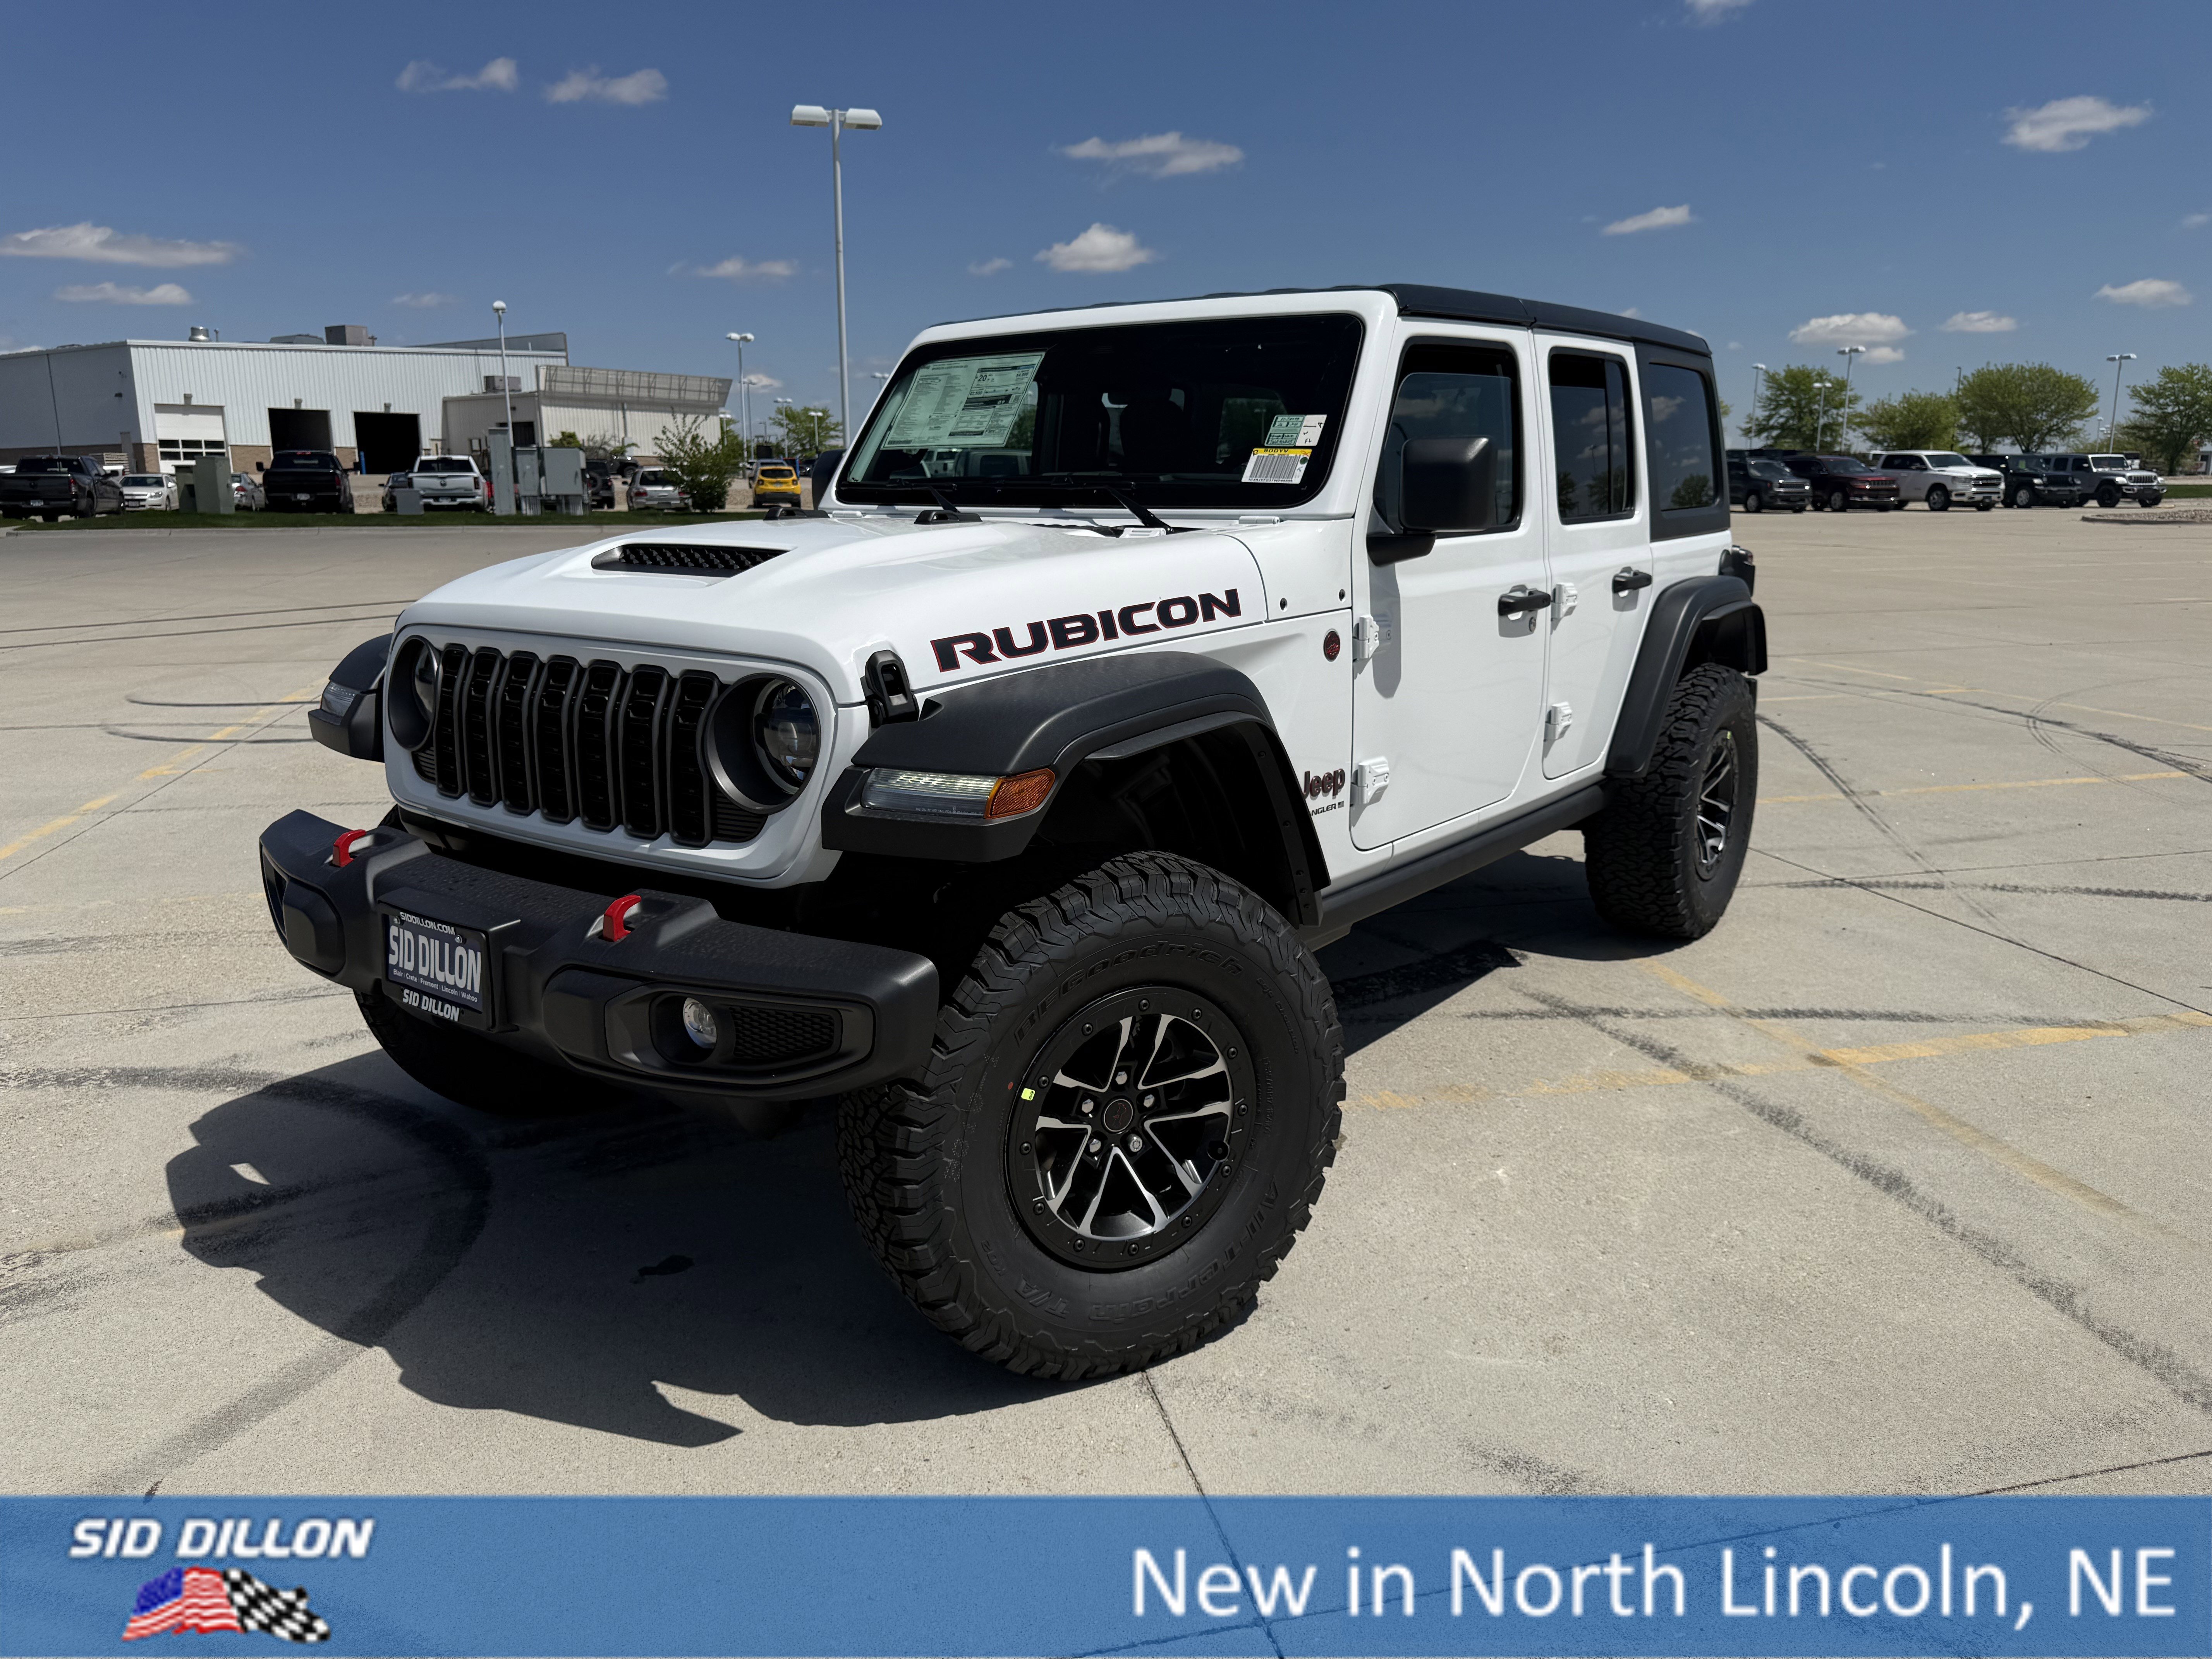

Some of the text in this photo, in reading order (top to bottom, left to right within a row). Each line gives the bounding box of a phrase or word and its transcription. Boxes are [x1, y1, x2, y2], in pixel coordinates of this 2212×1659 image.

[930, 588, 1242, 673] RUBICON
[1303, 768, 1345, 797] Jeep
[1311, 803, 1336, 816] NGLER
[400, 912, 455, 935] SIDDILLON.COM
[389, 925, 481, 993] SID DILLON
[406, 973, 417, 982] Crete
[420, 978, 438, 989] Fremont
[441, 985, 458, 996] Lincoln
[461, 991, 477, 1002] Wahoo
[1014, 941, 1244, 1046] BFGoodrich
[403, 989, 460, 1022] SID DILLON
